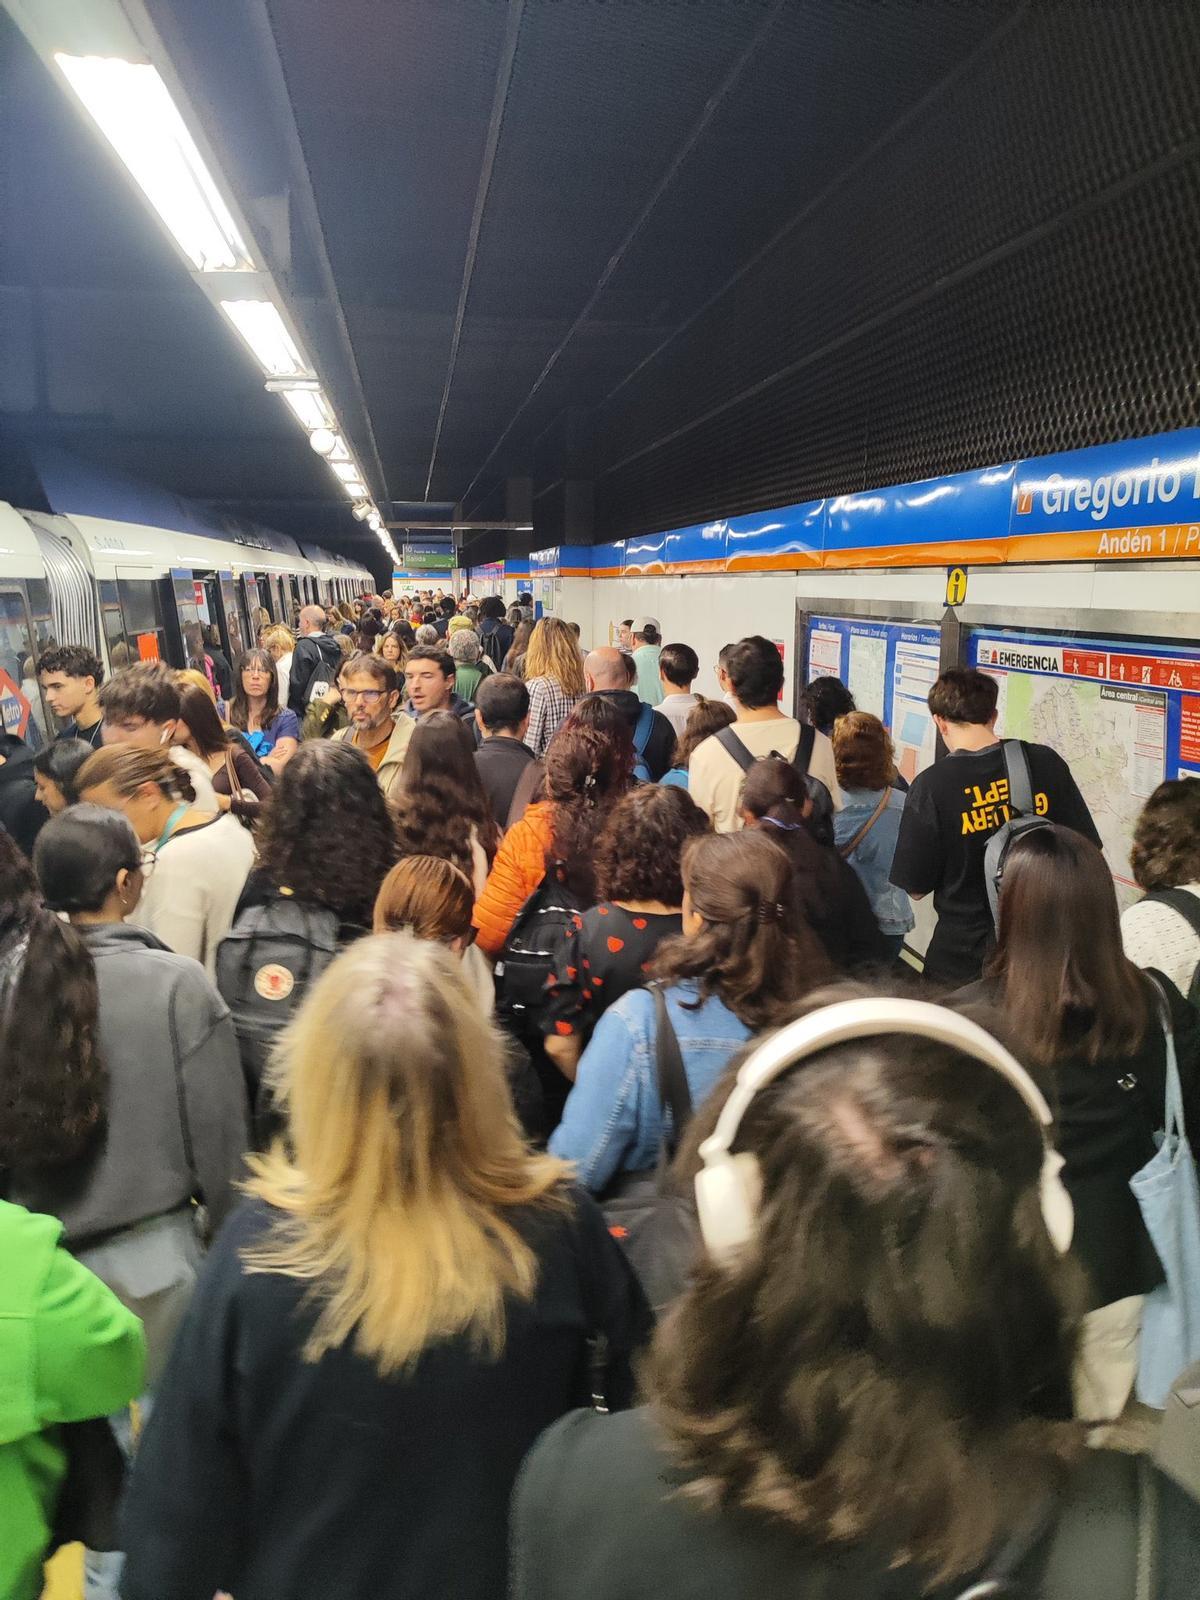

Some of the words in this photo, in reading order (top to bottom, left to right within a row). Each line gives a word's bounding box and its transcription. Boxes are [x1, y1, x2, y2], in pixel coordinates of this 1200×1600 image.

[1097, 529, 1152, 555] Andén
[1158, 528, 1167, 552] 1
[1000, 651, 1059, 673] EMERGENCIA
[1116, 691, 1138, 701] central
[964, 779, 1009, 808] EPT.
